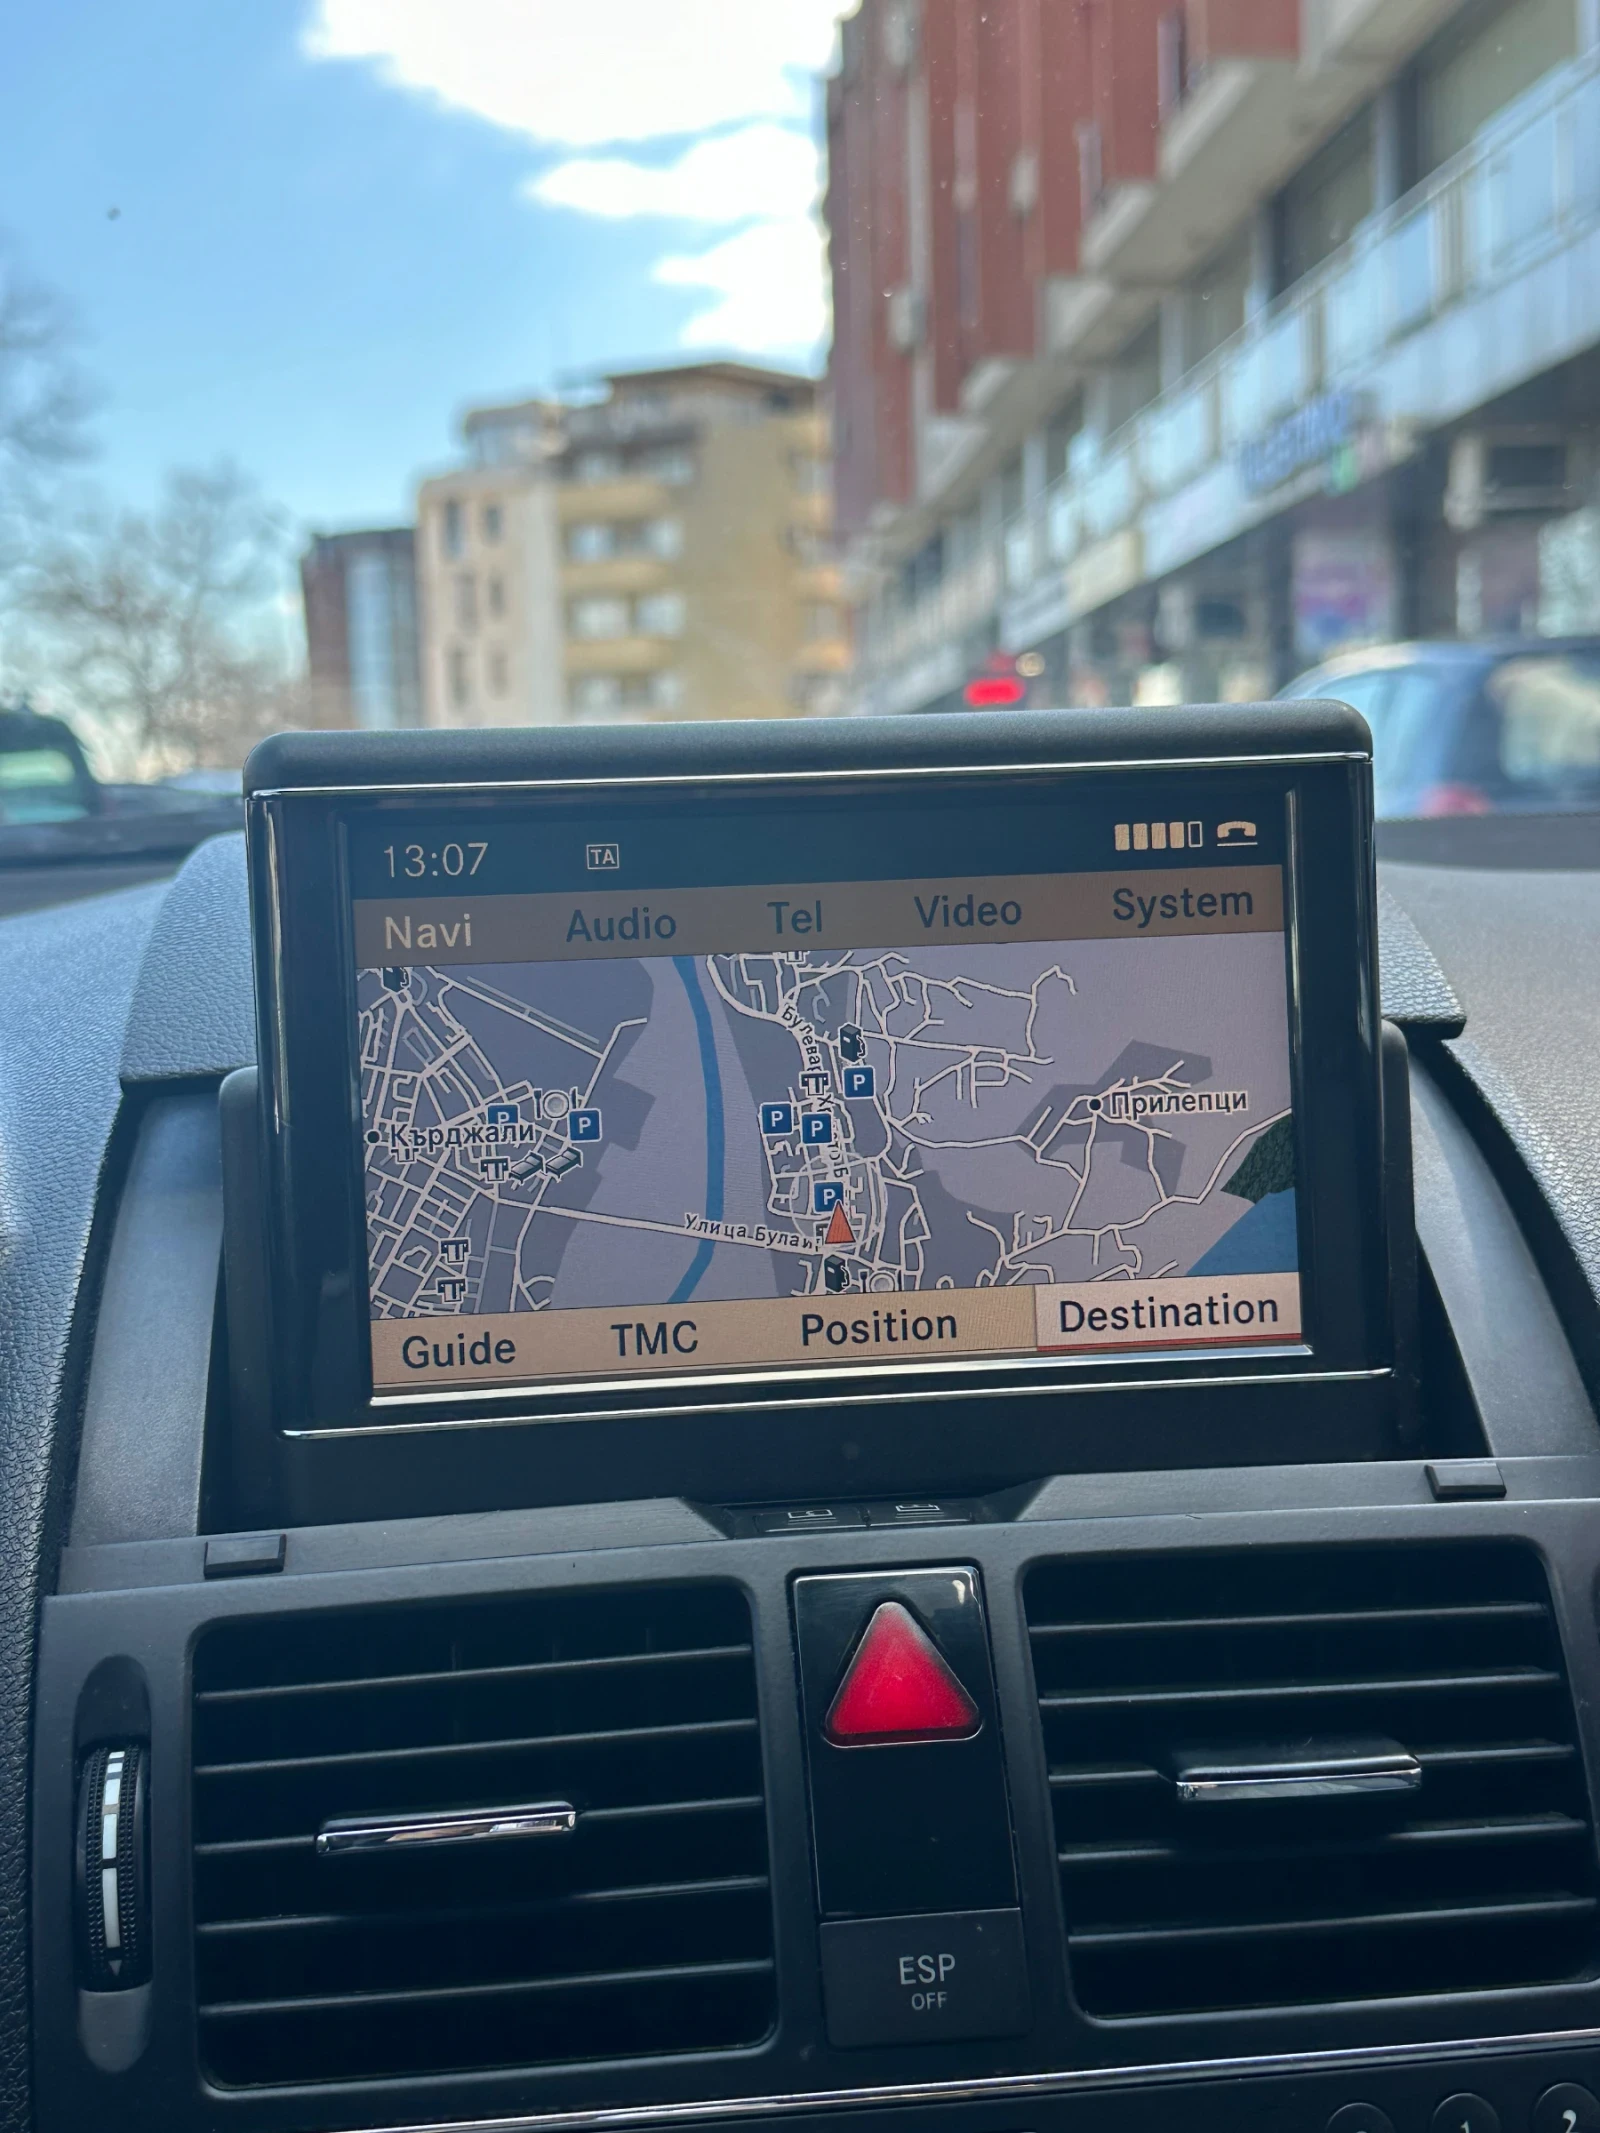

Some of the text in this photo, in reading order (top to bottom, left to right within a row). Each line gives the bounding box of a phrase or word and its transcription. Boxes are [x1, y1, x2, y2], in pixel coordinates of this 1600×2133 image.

[383, 842, 489, 878] 13:07
[589, 848, 616, 866] TA
[384, 886, 1255, 950] Navi Audio Tel Video System
[1111, 1091, 1248, 1121] Прилепци
[390, 1123, 536, 1154] Кърджали
[684, 1213, 747, 1239] Улица
[402, 1293, 1279, 1369] Guide TMC Position Destination
[898, 1953, 956, 1985] ESP
[911, 1991, 948, 2011] OFF
